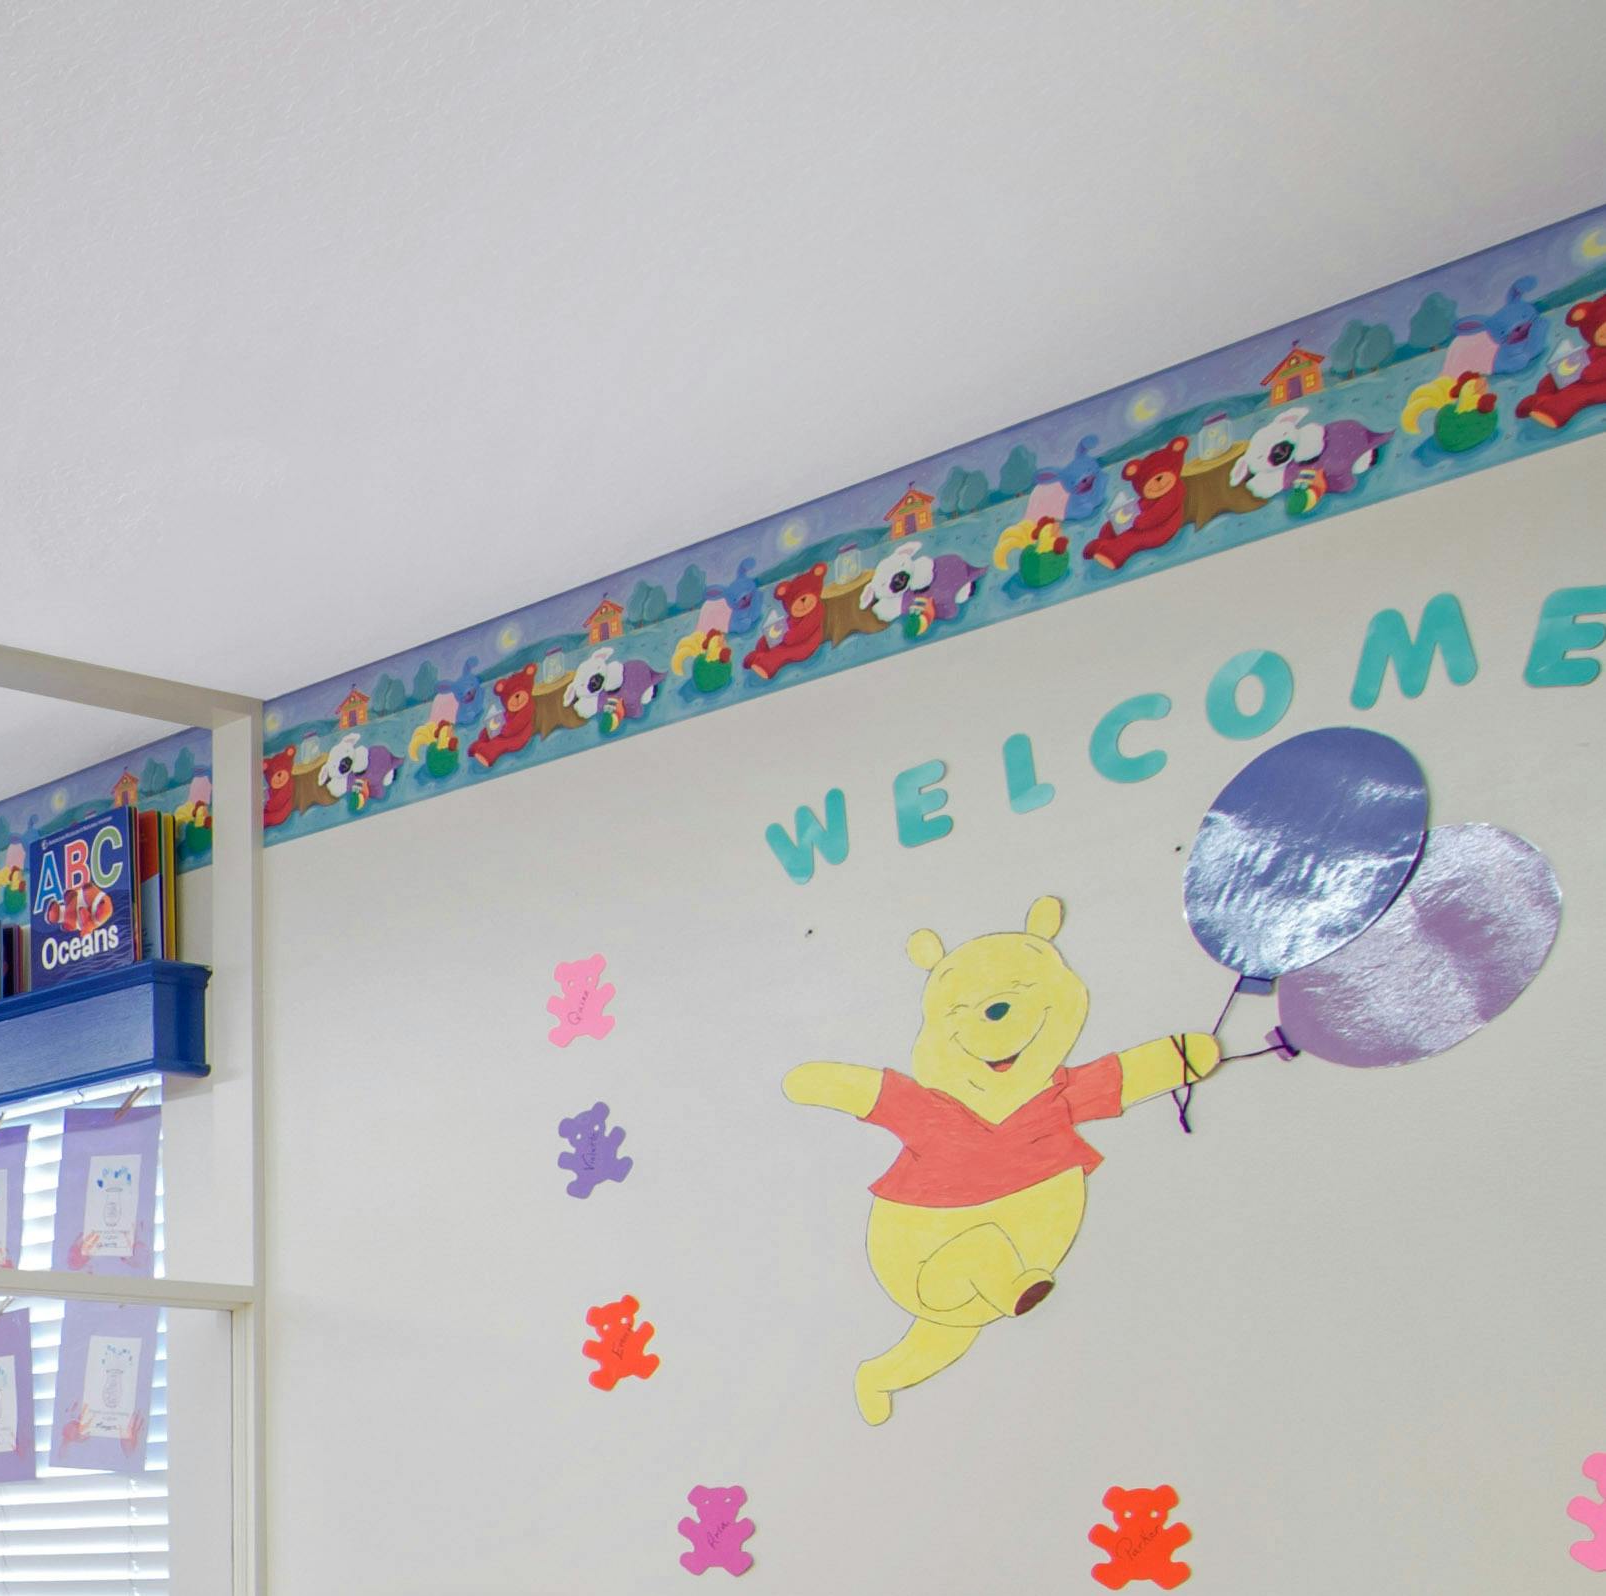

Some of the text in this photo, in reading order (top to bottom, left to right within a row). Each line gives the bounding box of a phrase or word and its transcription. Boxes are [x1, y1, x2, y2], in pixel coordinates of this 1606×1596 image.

[764, 586, 1606, 886] WELCOME
[33, 825, 123, 914] ABC
[41, 924, 119, 970] Oceans
[1115, 1524, 1161, 1560] Parker
